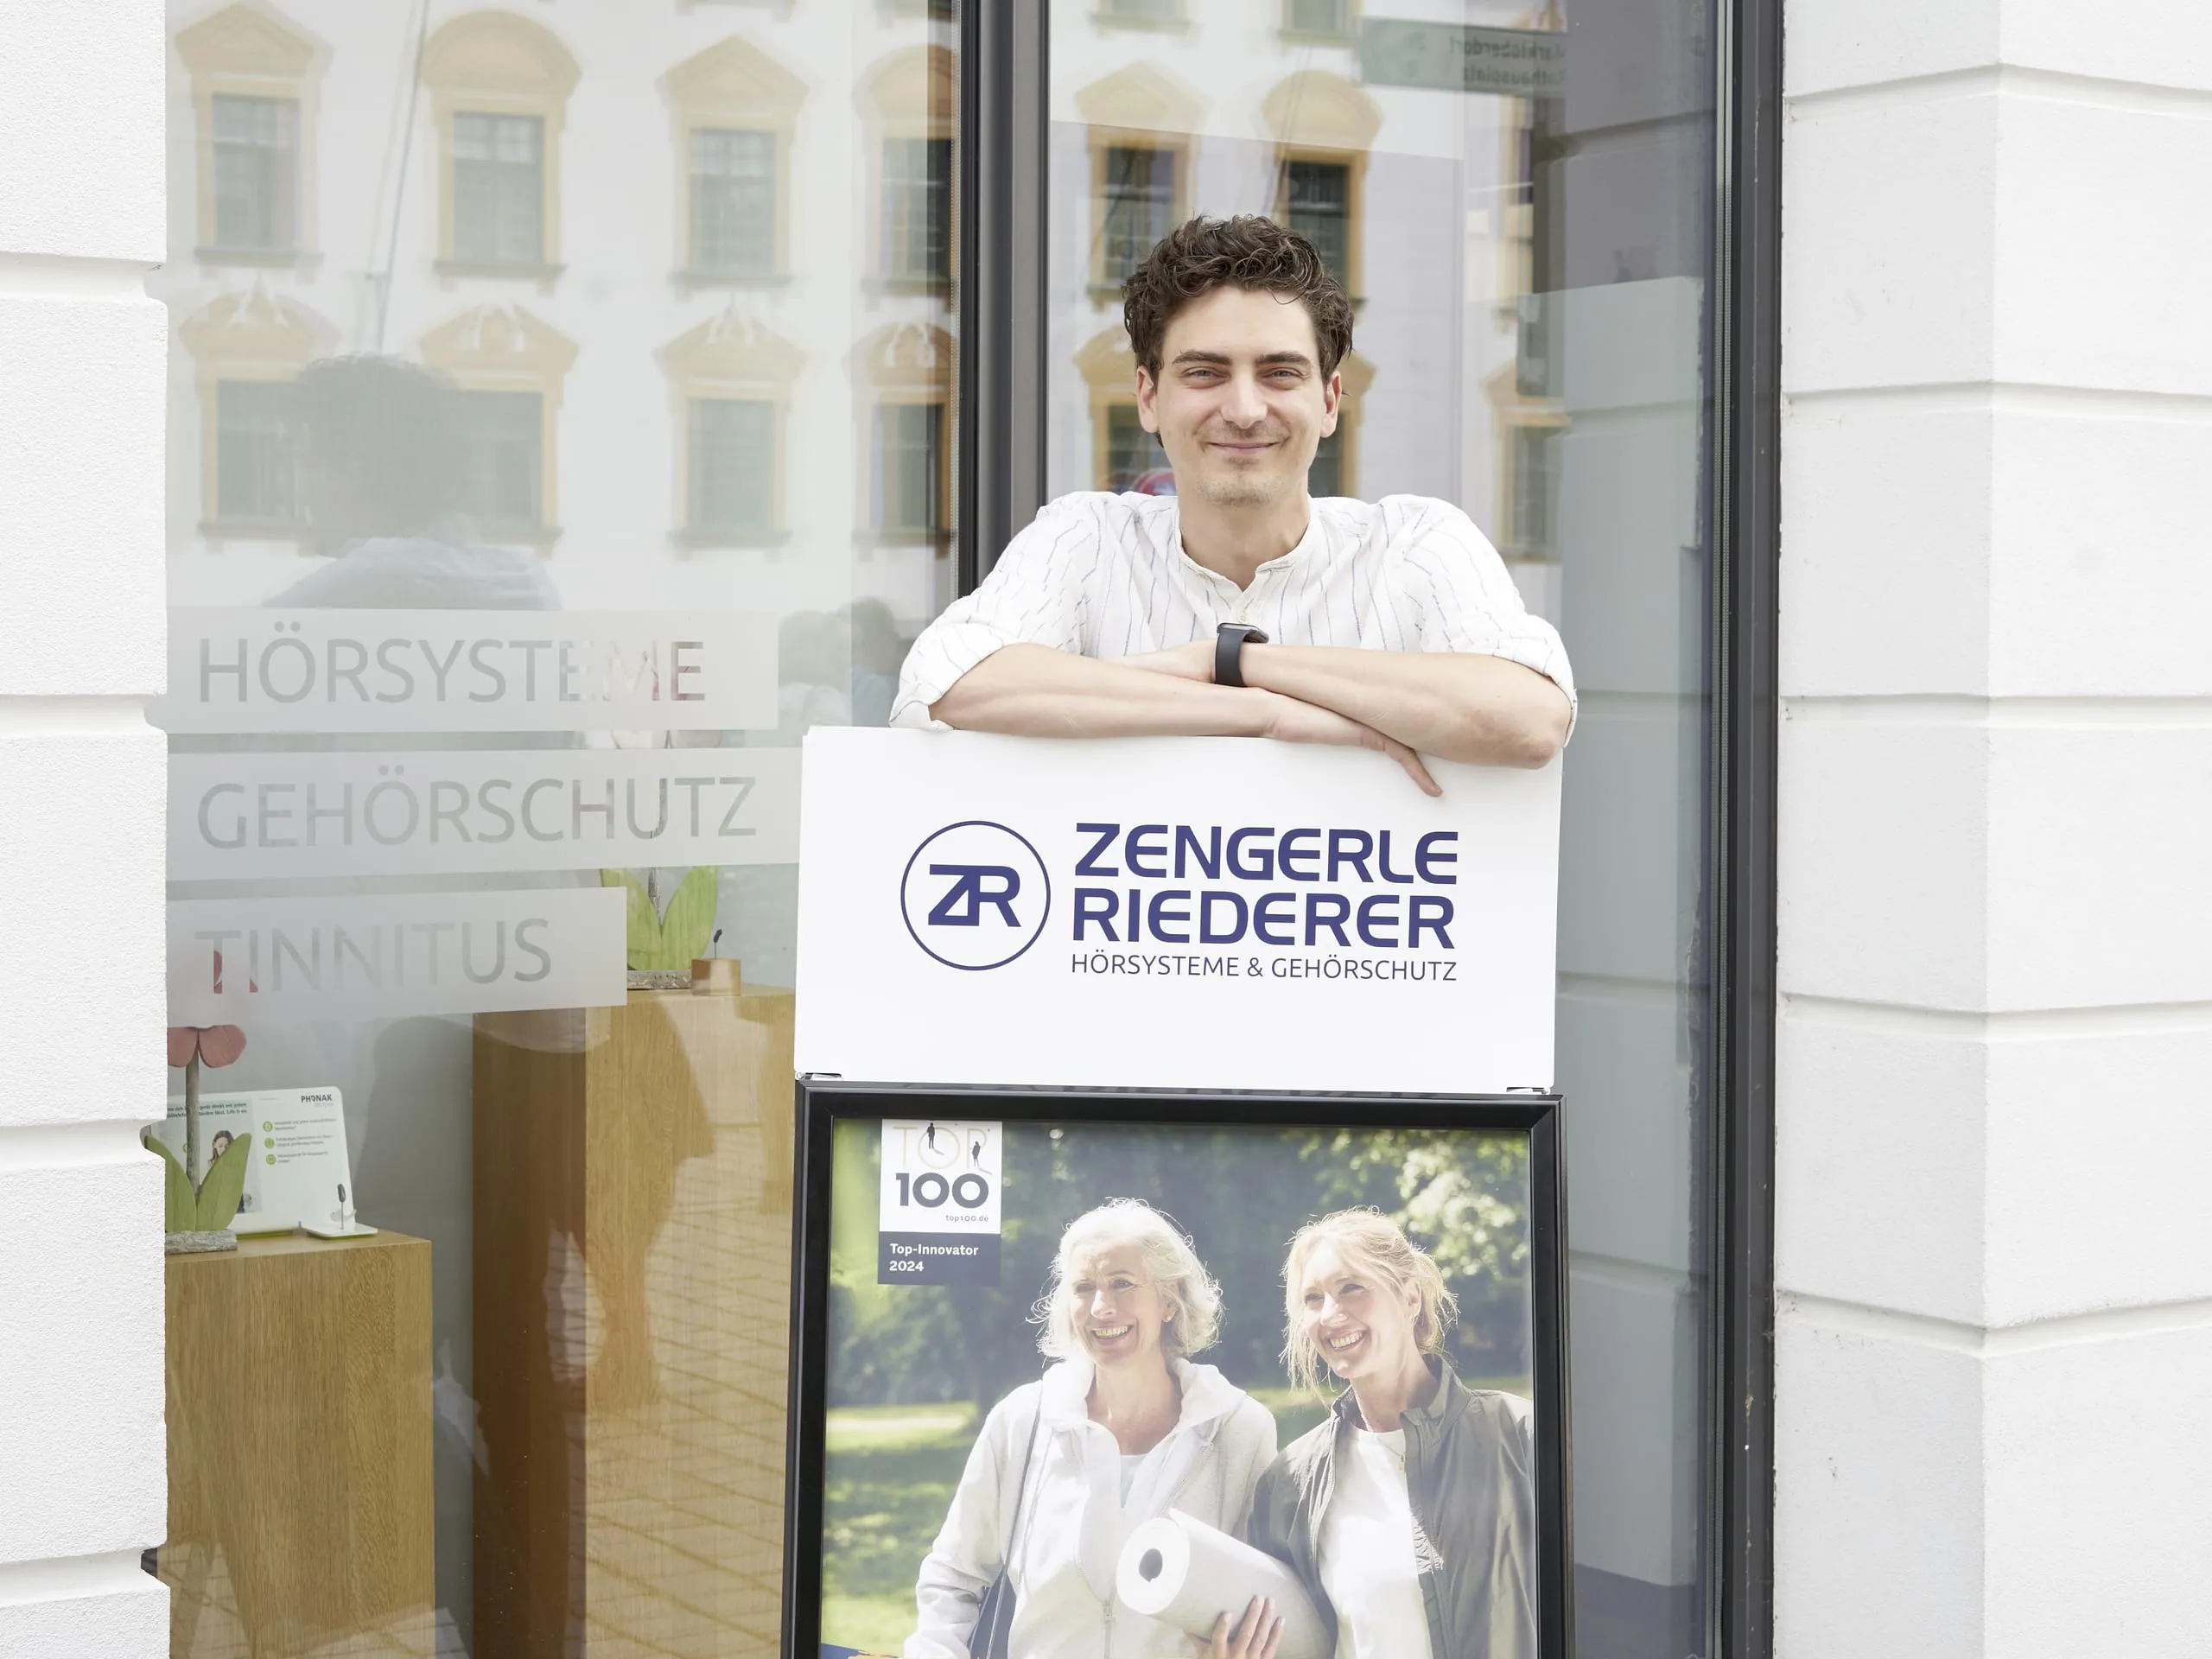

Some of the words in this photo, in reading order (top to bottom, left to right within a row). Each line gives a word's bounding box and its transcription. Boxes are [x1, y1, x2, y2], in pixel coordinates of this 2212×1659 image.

[198, 620, 706, 703] HÖRSYSTEME
[198, 765, 757, 849] GEHÖRSCHUTZ
[1074, 822, 1459, 885] ZENGERLE
[927, 863, 1021, 928] ZR
[1072, 887, 1455, 950] RIEDERER
[194, 918, 552, 994] TINNITUS
[1071, 949, 1239, 976] HÖRSYSTEME
[1247, 957, 1264, 977] &
[1271, 954, 1457, 981] GEHÖRSCHUTZ
[301, 1094, 333, 1103] PHONAK
[893, 1126, 987, 1169] TOP
[895, 1172, 989, 1209] 100
[945, 1214, 988, 1223] top100.de
[888, 1260, 925, 1272] 2024
[889, 1243, 979, 1256] Top-Innovator
